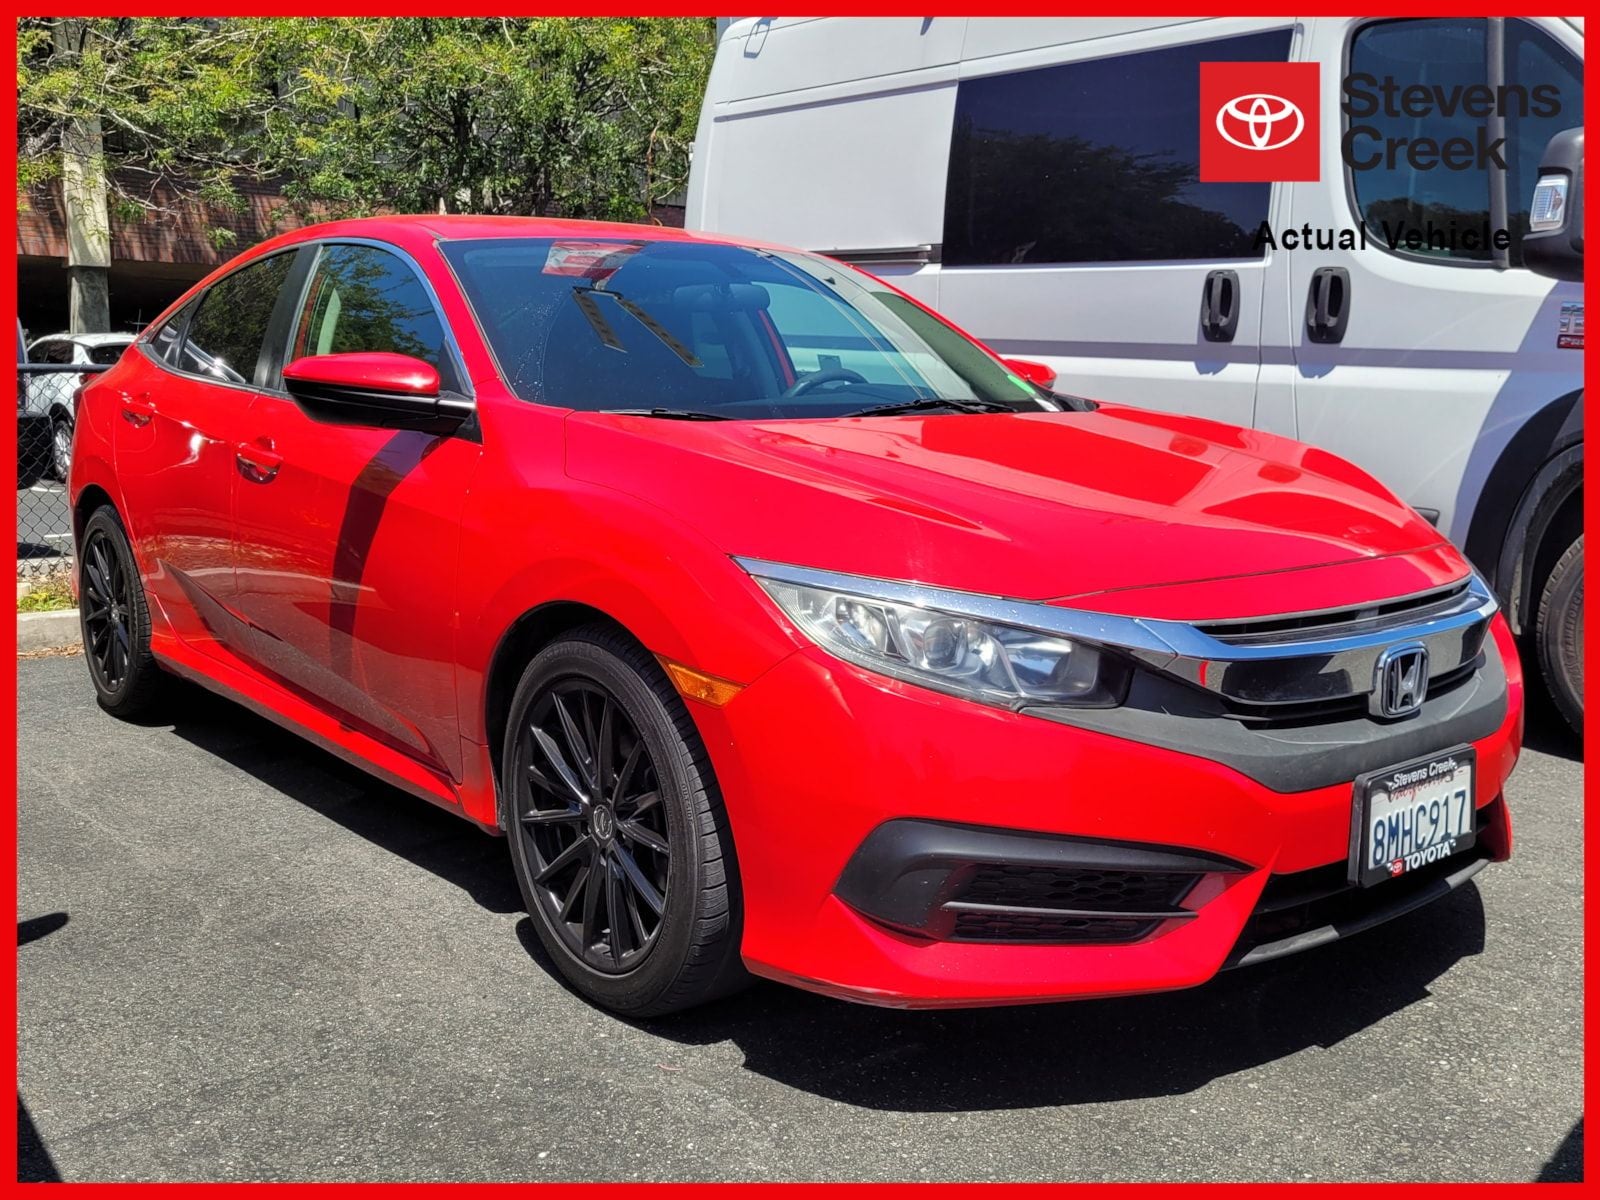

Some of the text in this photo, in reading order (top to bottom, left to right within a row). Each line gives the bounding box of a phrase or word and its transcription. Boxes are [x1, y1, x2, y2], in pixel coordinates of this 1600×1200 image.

[1393, 768, 1427, 787] Stevens
[1429, 757, 1454, 776] Creek
[1372, 789, 1466, 865] 8MHC917
[1404, 841, 1451, 872] TOYOTA
